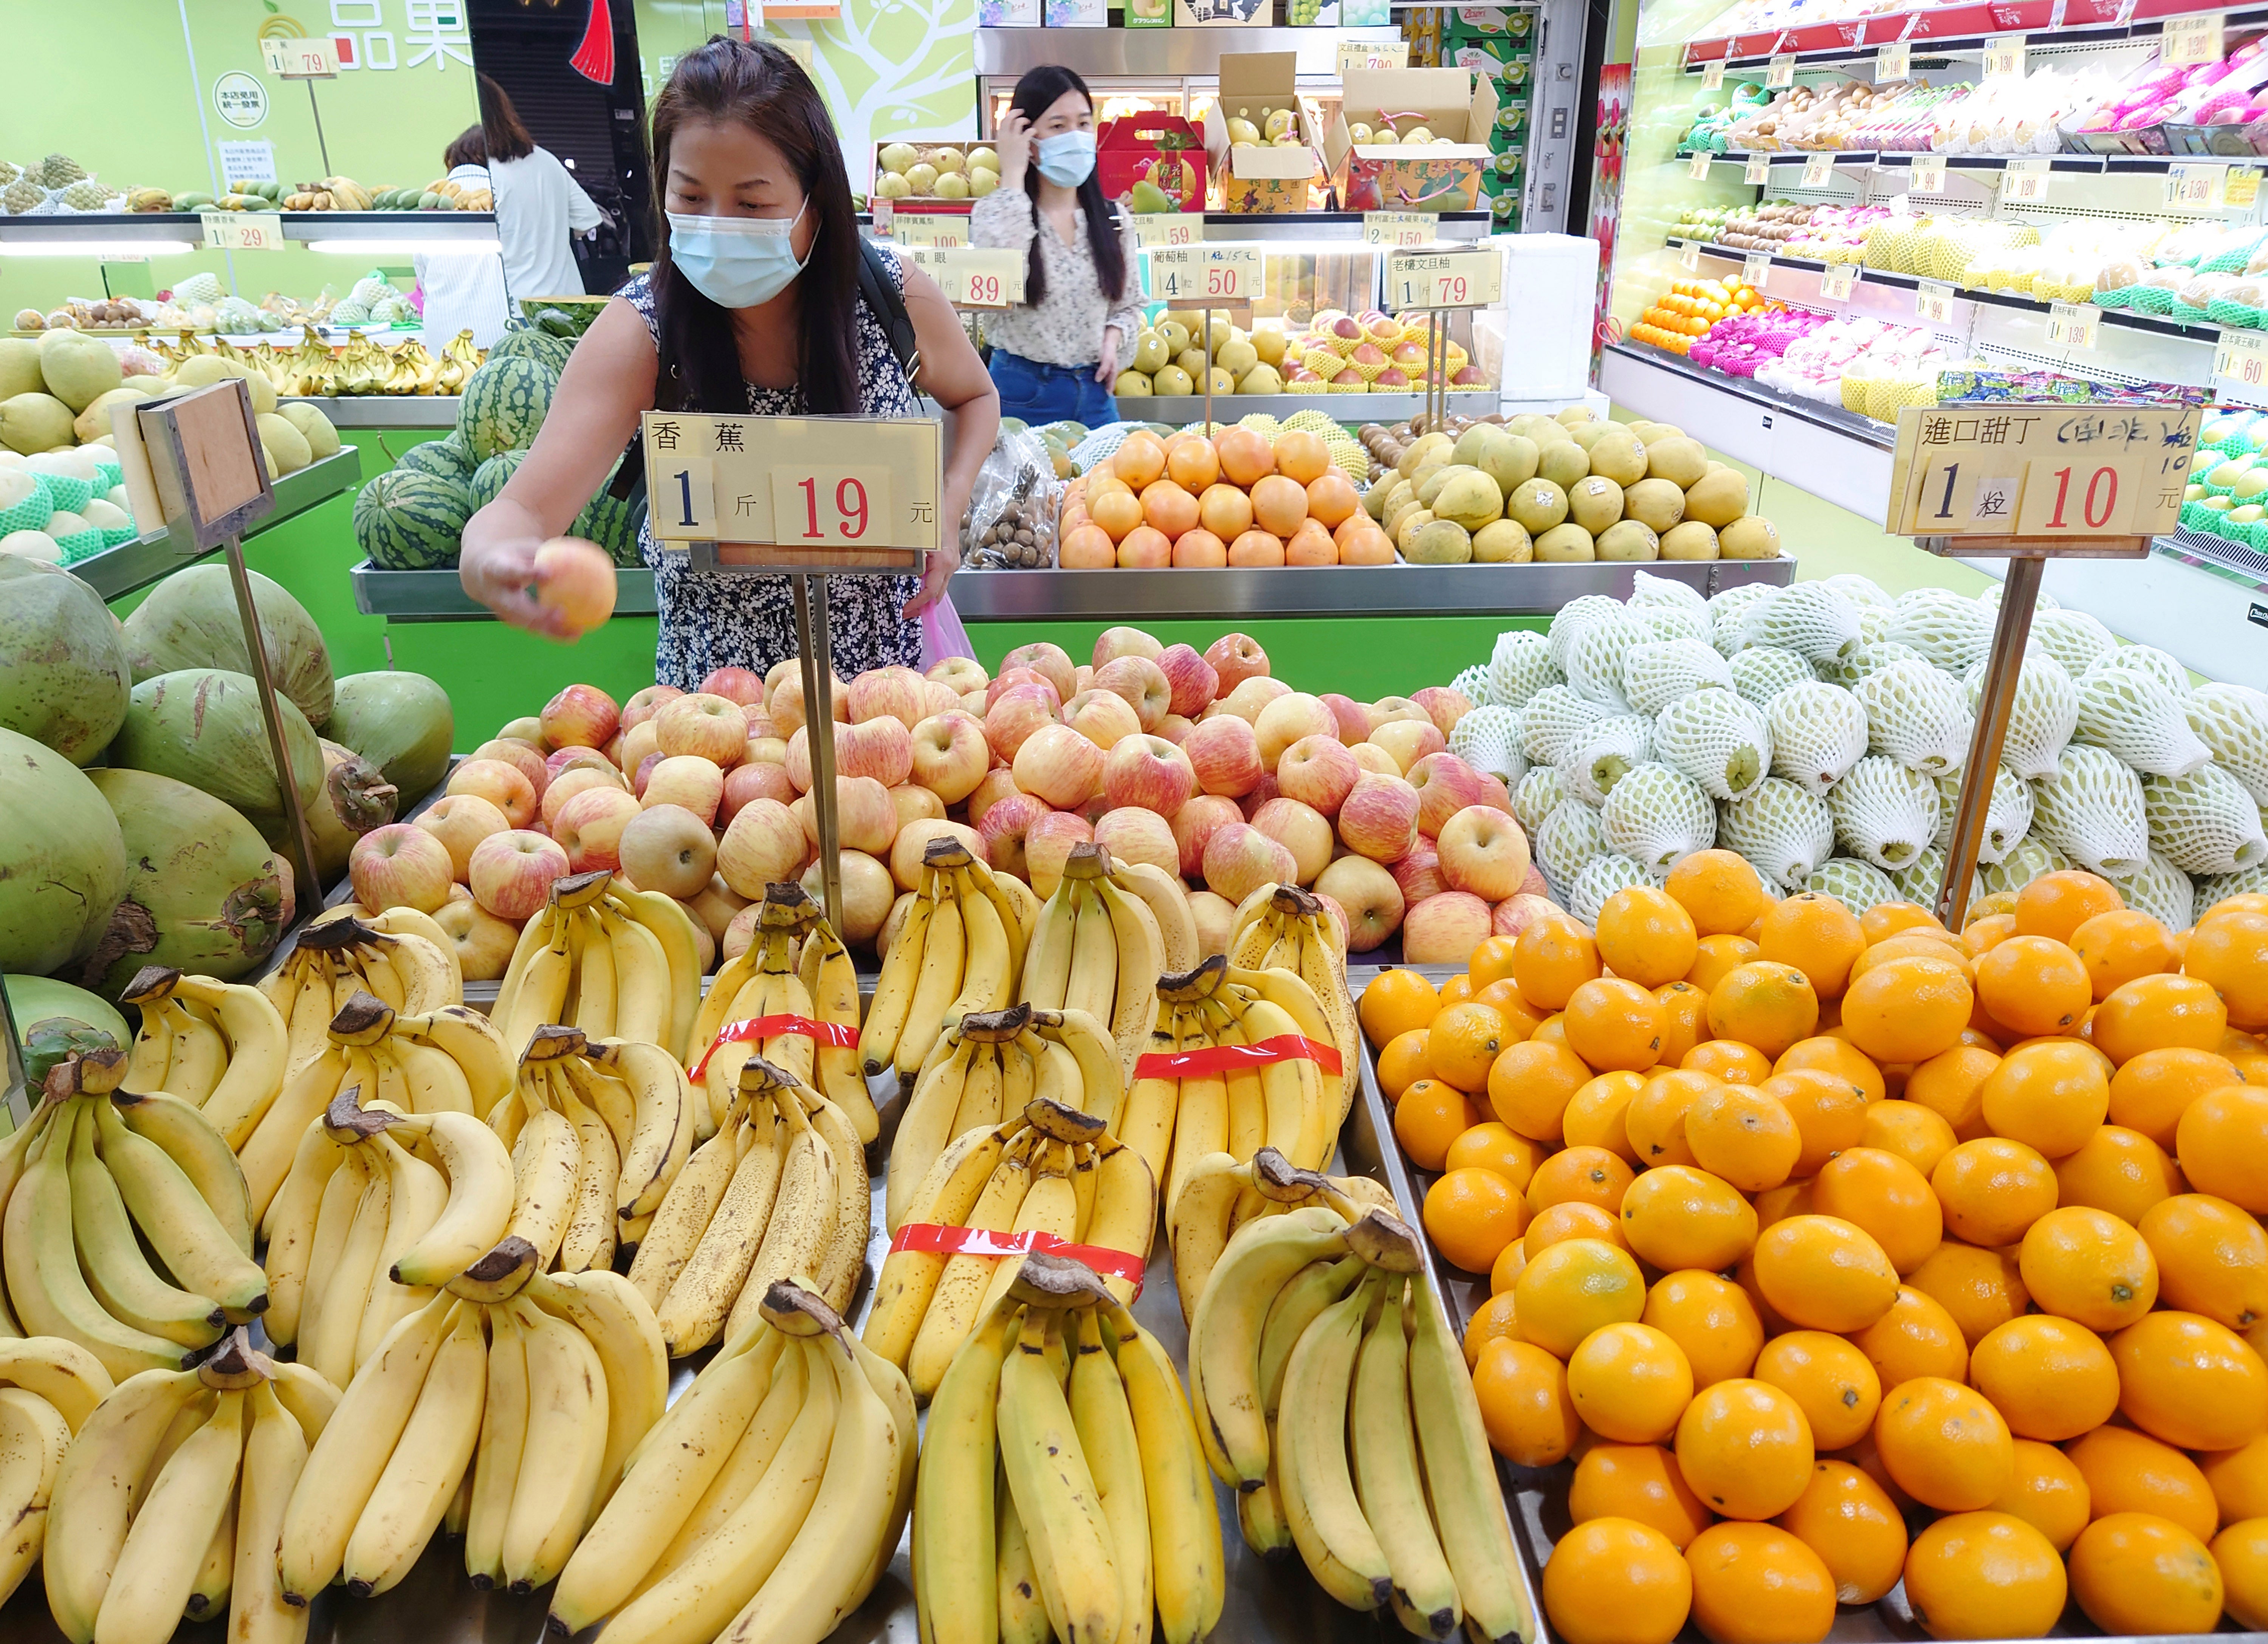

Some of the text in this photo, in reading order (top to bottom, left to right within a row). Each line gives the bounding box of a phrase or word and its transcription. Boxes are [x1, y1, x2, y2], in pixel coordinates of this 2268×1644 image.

[272, 54, 322, 71] 1 79
[1890, 60, 1901, 75] 140
[2000, 56, 2013, 71] 130
[1925, 172, 1935, 190] 99
[2020, 180, 2036, 196] 120
[2188, 180, 2208, 199] 130
[213, 228, 262, 246] 1 29
[934, 236, 957, 248] 100
[1136, 233, 1142, 248] 1
[1170, 226, 1189, 245] 59
[1371, 229, 1379, 244] 2
[1399, 232, 1422, 246] 150
[915, 252, 946, 263] 龍眼
[1154, 251, 1187, 263] 葡萄柚
[970, 275, 999, 302] 89
[1165, 272, 1178, 295] 4
[1208, 269, 1236, 294] 50
[1404, 281, 1413, 304] 1
[1438, 277, 1466, 303] 79
[1834, 280, 1842, 296] 65
[1932, 301, 1942, 319] 99
[2050, 321, 2056, 338] 1
[2068, 327, 2084, 343] 139
[2218, 352, 2225, 372] 1
[2244, 359, 2262, 384] 60
[652, 421, 745, 453] 香蕉
[1922, 416, 2042, 445] 進口甜丁
[2161, 456, 2188, 474] 10
[673, 470, 933, 539] 1 斤 19 元
[1934, 462, 1960, 518] 1
[2045, 466, 2119, 529] 10
[2155, 488, 2180, 509] 元
